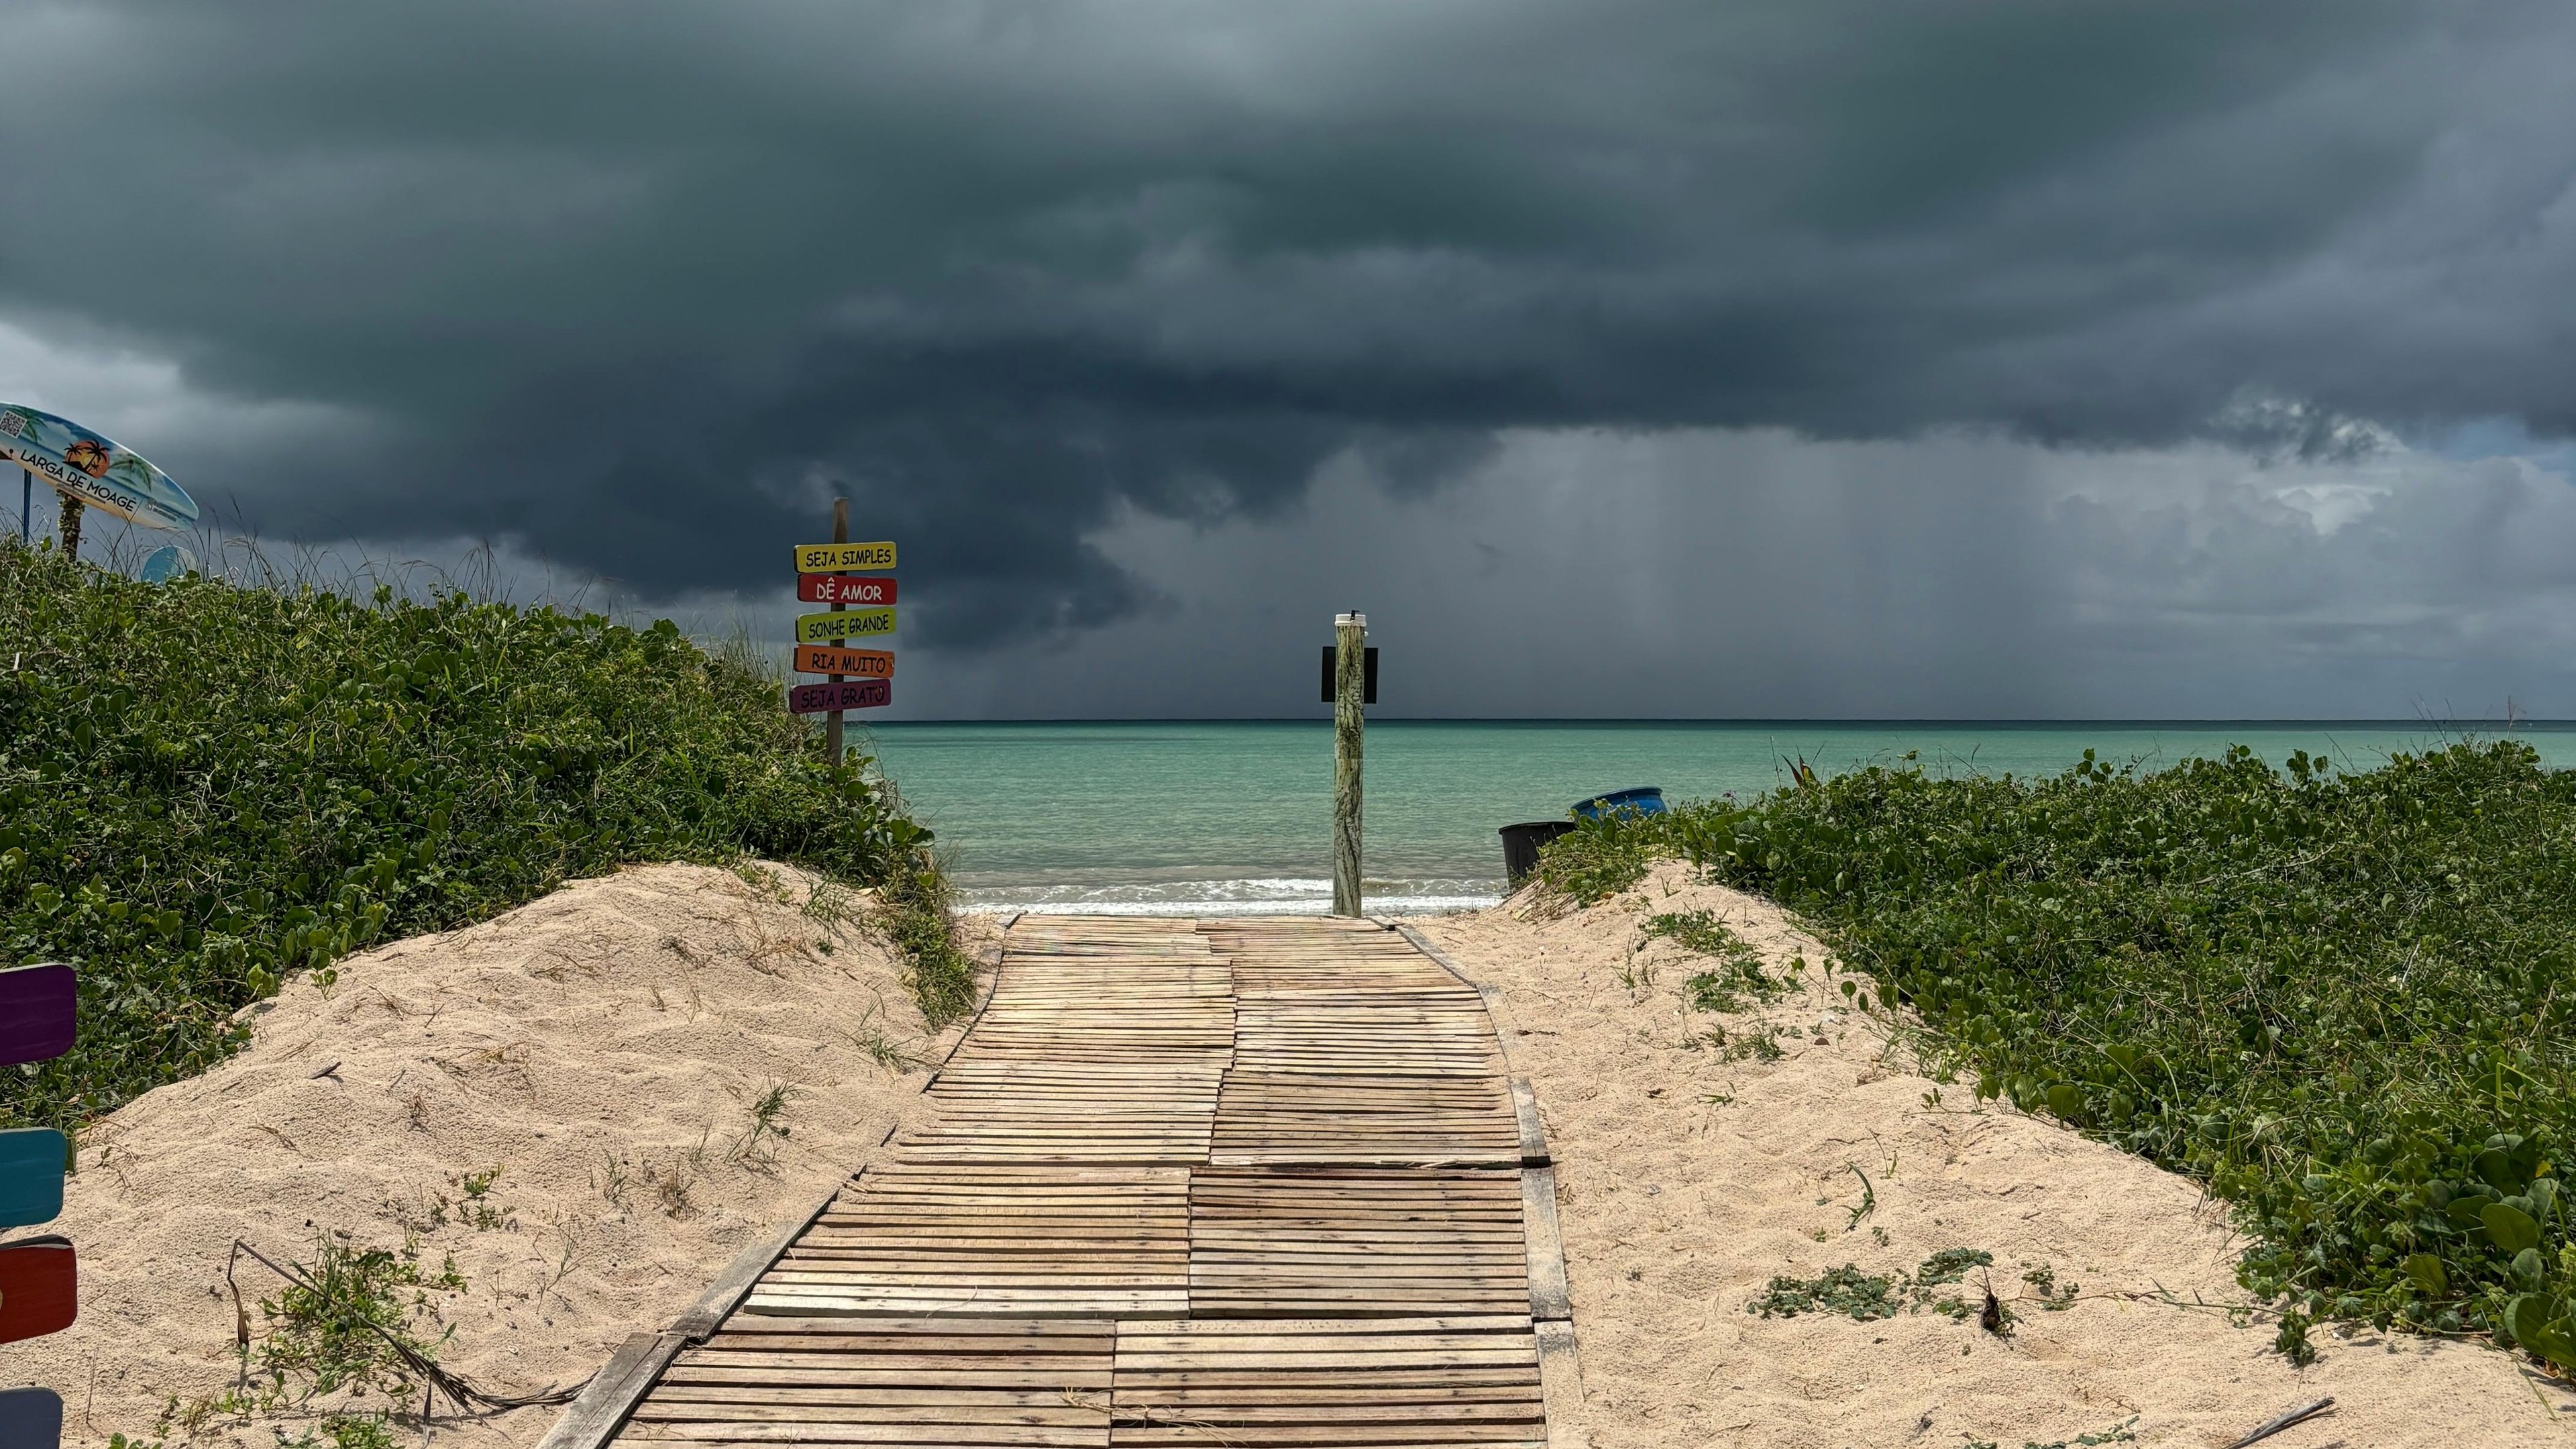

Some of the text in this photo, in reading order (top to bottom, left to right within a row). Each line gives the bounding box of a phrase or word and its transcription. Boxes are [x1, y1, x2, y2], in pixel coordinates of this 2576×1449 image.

[20, 449, 64, 478] LARGA
[66, 471, 87, 488] DE
[806, 549, 892, 567] SEJA SIMPLES
[816, 577, 882, 601] DÊ AMOR
[809, 614, 890, 639] SONHE GRANDE
[812, 653, 885, 673] RIA MUITO
[801, 690, 835, 708] SEJA
